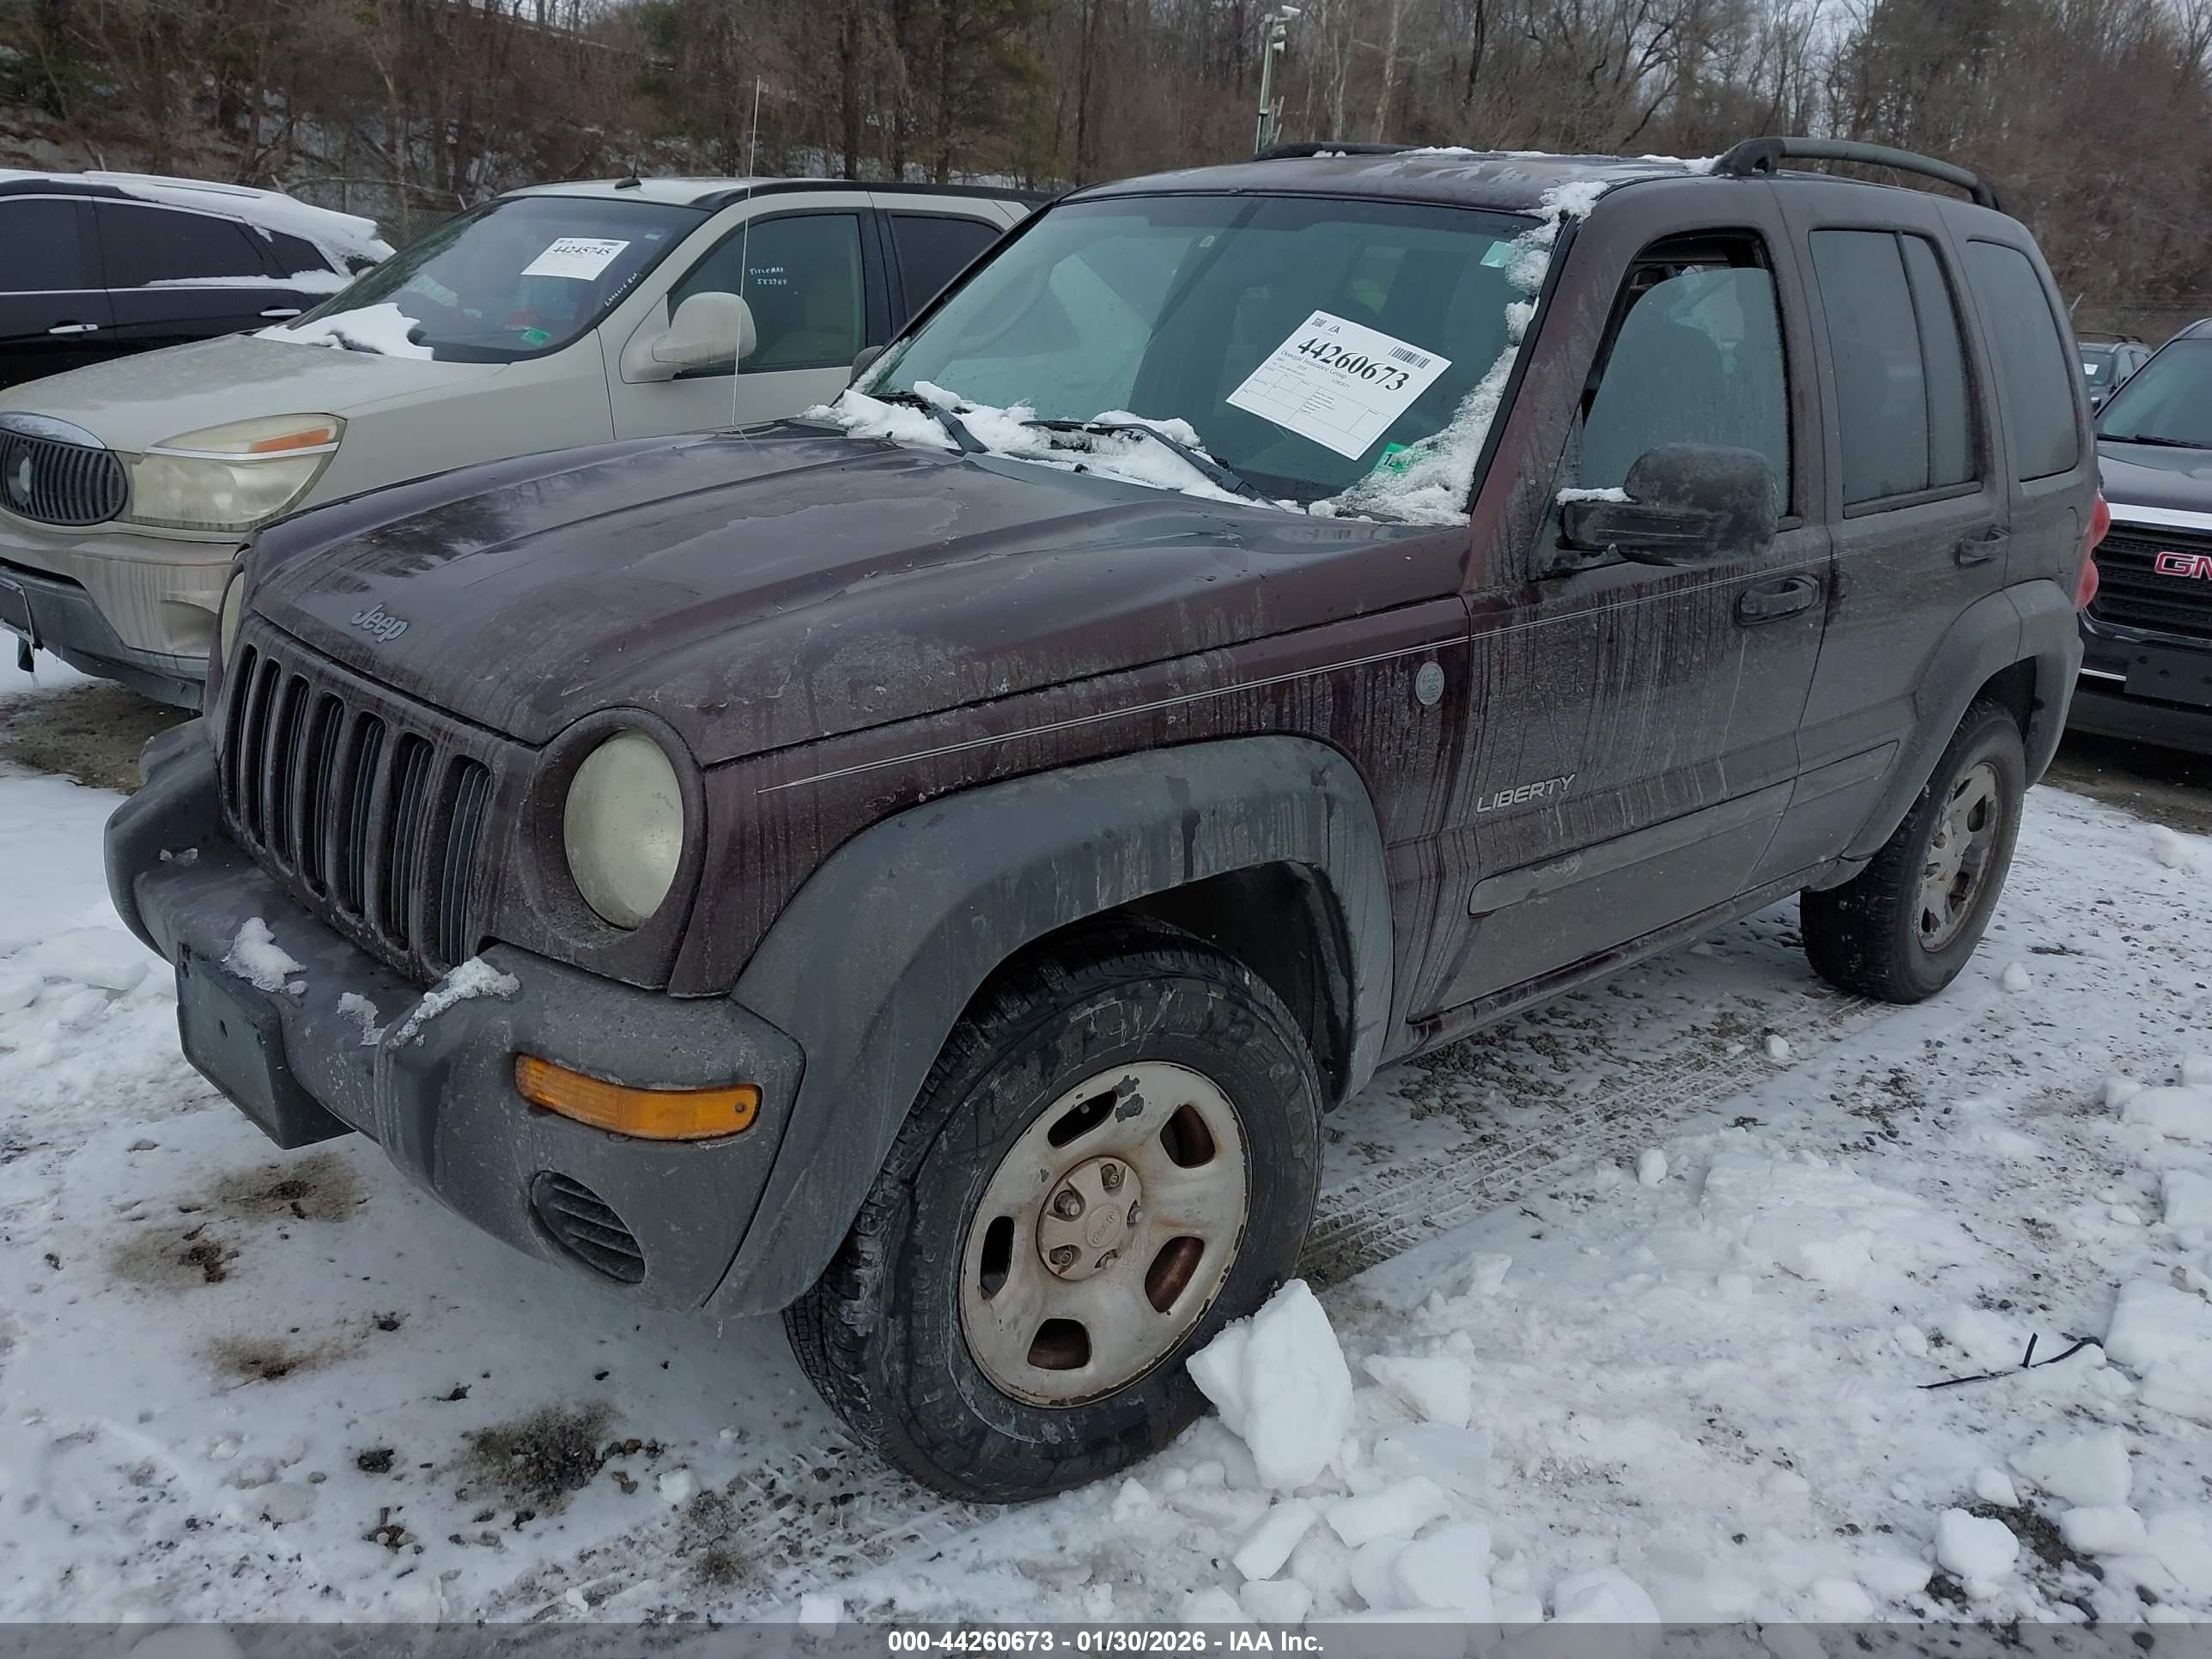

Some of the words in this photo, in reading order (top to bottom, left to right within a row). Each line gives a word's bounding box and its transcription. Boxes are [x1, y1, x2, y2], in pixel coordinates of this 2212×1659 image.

[1297, 337, 1410, 392] 44260673
[1303, 357, 1330, 373] Insurance
[1329, 368, 1348, 380] Group
[350, 604, 408, 643] Jeep
[1476, 773, 1576, 813] LIBERTY
